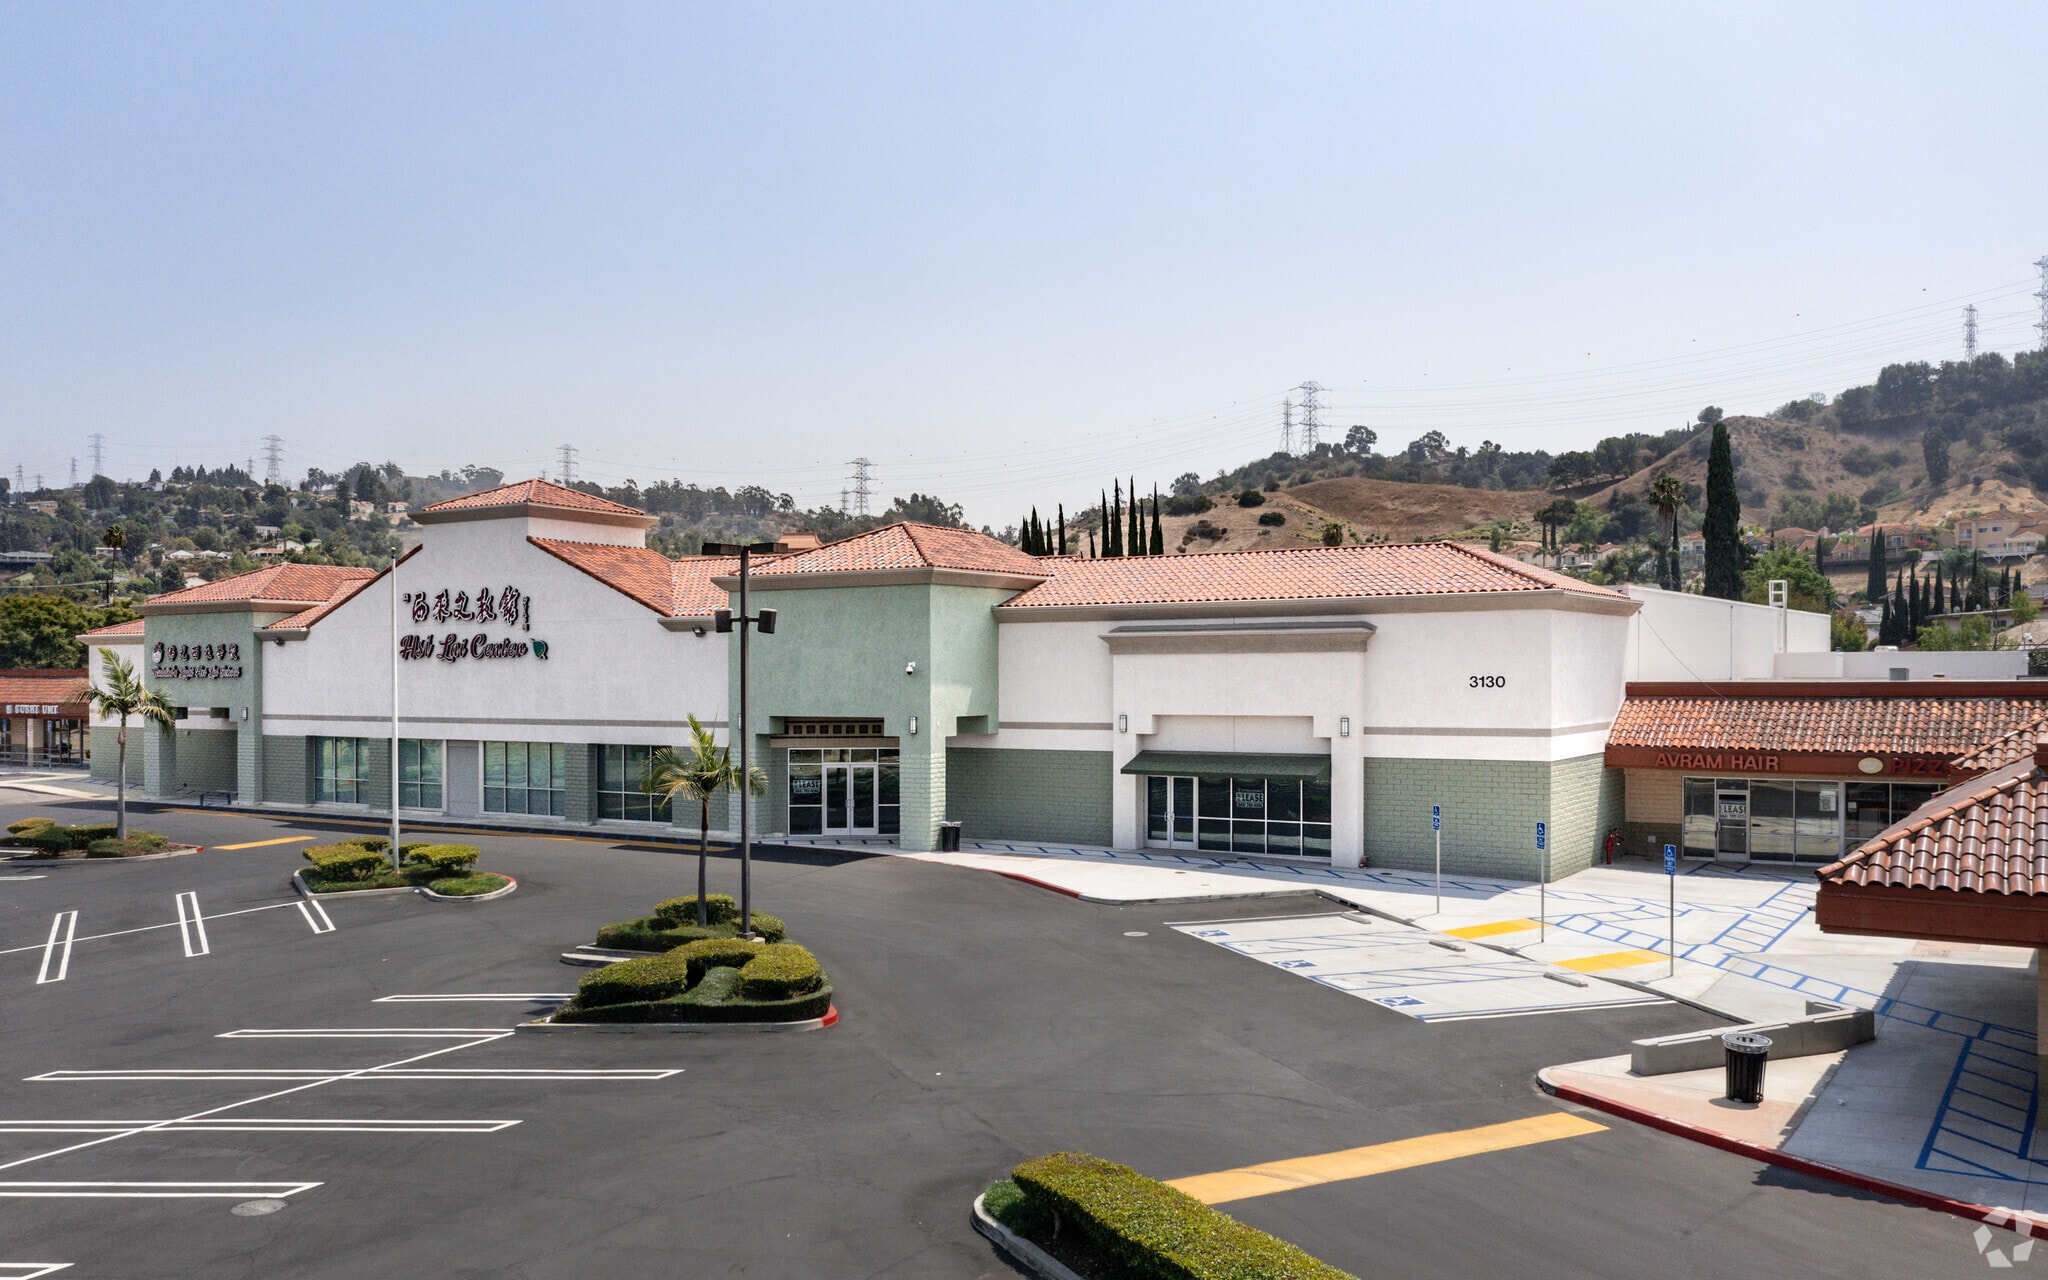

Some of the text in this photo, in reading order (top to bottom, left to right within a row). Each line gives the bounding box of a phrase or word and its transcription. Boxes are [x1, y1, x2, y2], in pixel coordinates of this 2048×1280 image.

[399, 633, 528, 663] Hsi Lai Center
[1469, 675, 1506, 688] 3130
[1655, 752, 1779, 771] AVRAM HAIR
[1890, 757, 1951, 775] PIZZ
